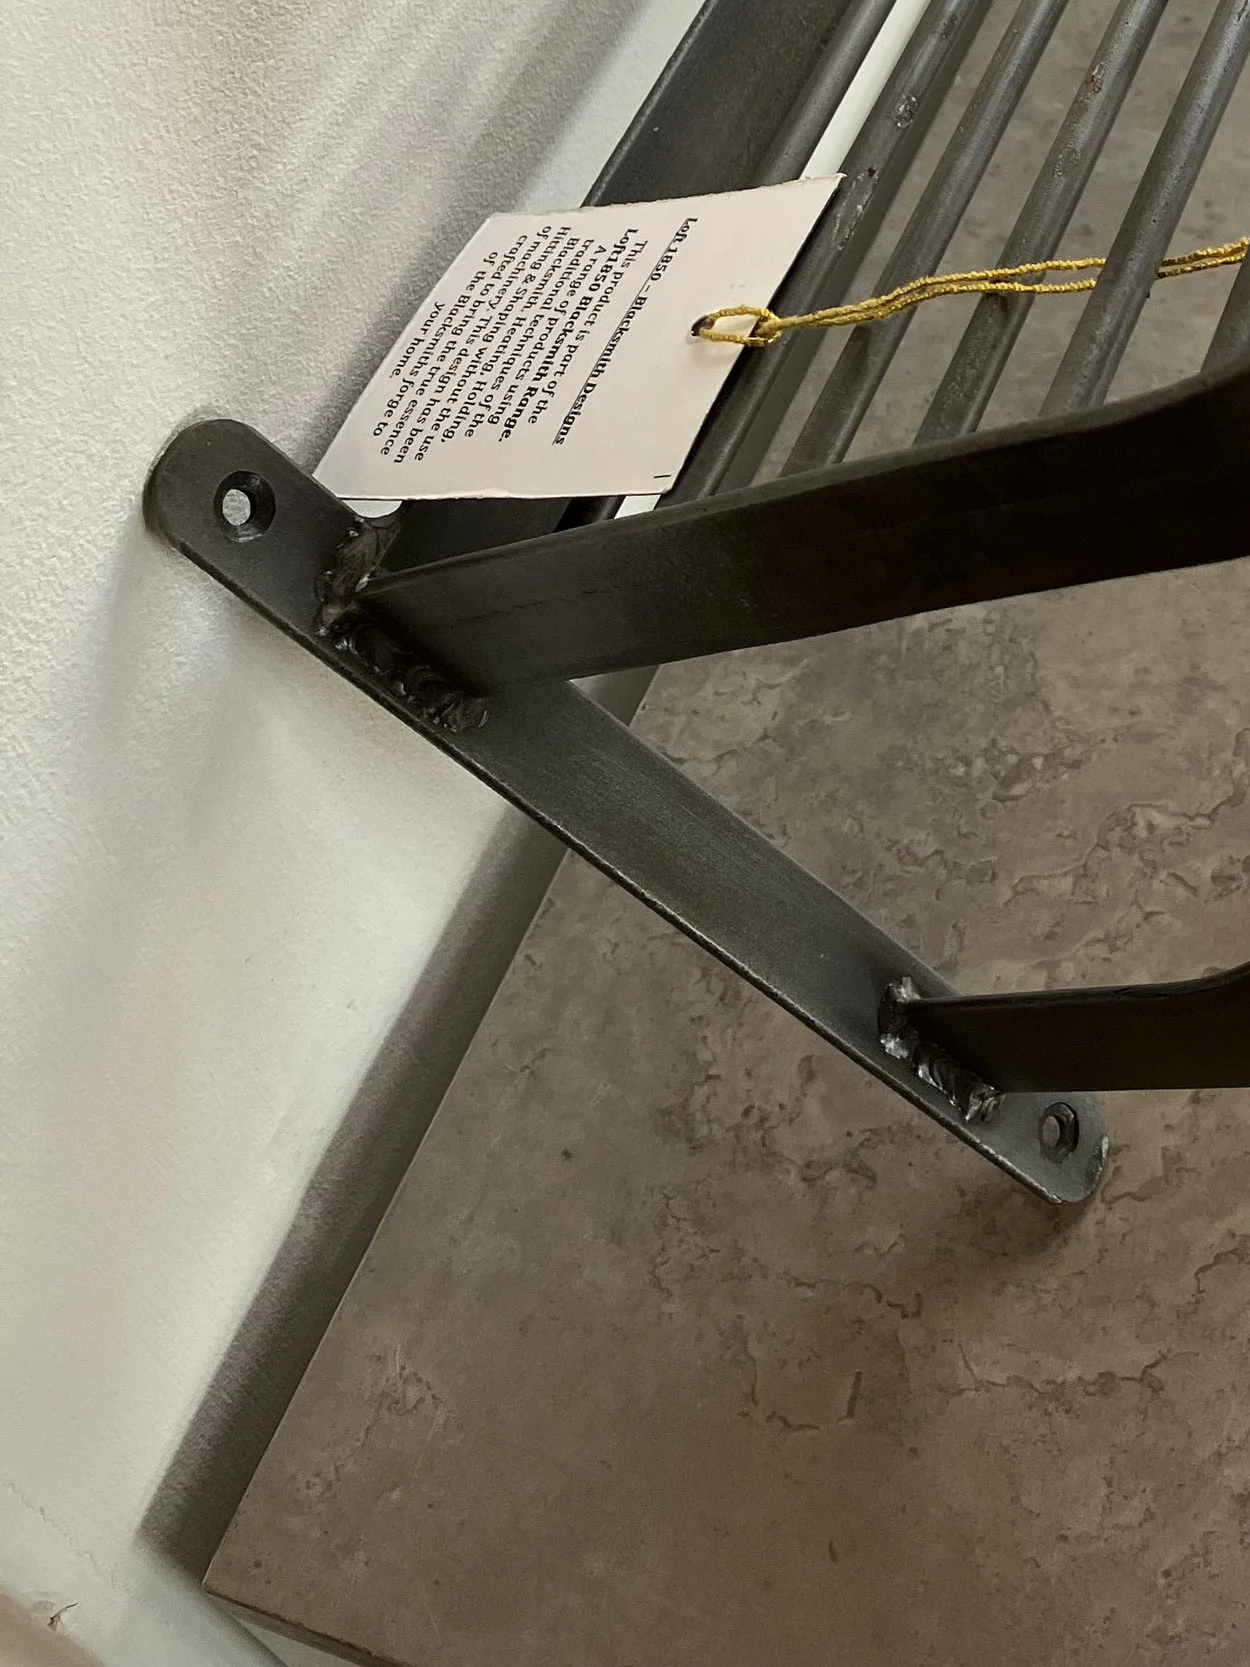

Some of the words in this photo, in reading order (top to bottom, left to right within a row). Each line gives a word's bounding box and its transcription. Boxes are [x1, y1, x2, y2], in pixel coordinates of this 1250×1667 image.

[529, 226, 571, 270] Hitting
[536, 225, 551, 240] of
[593, 244, 606, 254] A
[668, 217, 698, 245] Loft
[482, 251, 498, 266] of
[490, 234, 527, 279] crafted
[588, 228, 638, 291] Loft1850
[620, 240, 648, 267] This
[644, 246, 677, 283] 1850
[465, 270, 486, 291] the
[479, 283, 495, 296] to
[486, 241, 541, 311] machinery.
[520, 237, 580, 312] Blacksmith.
[521, 273, 536, 284] &
[539, 238, 594, 310] traditional
[566, 257, 598, 296] range
[481, 286, 527, 342] Shaping
[553, 300, 569, 316] of
[583, 271, 624, 326] product
[408, 294, 471, 376] Blacksmiths
[419, 301, 445, 335] your
[450, 299, 485, 336] bring
[465, 315, 492, 344] This
[574, 329, 590, 341] is
[436, 340, 457, 362] the
[479, 316, 527, 375] Heating,
[490, 313, 544, 390] techniques
[514, 317, 559, 380] products
[531, 295, 593, 382] Blacksmith
[586, 294, 648, 379] Blacksmith
[388, 337, 425, 378] home.
[433, 347, 469, 393] design
[446, 346, 487, 404] without
[553, 344, 579, 377] part
[383, 377, 414, 417] forge
[415, 366, 441, 396] true
[541, 380, 557, 397] of
[416, 397, 441, 424] has
[430, 407, 451, 431] the
[440, 380, 487, 442] Holding,
[478, 394, 493, 411] of
[486, 384, 519, 424] using
[498, 385, 539, 442] Range.
[527, 399, 548, 424] the
[551, 381, 597, 445] Designs
[372, 421, 388, 436] to
[380, 399, 417, 455] essence
[464, 413, 485, 437] the
[393, 427, 423, 463] been
[414, 435, 434, 461] use
